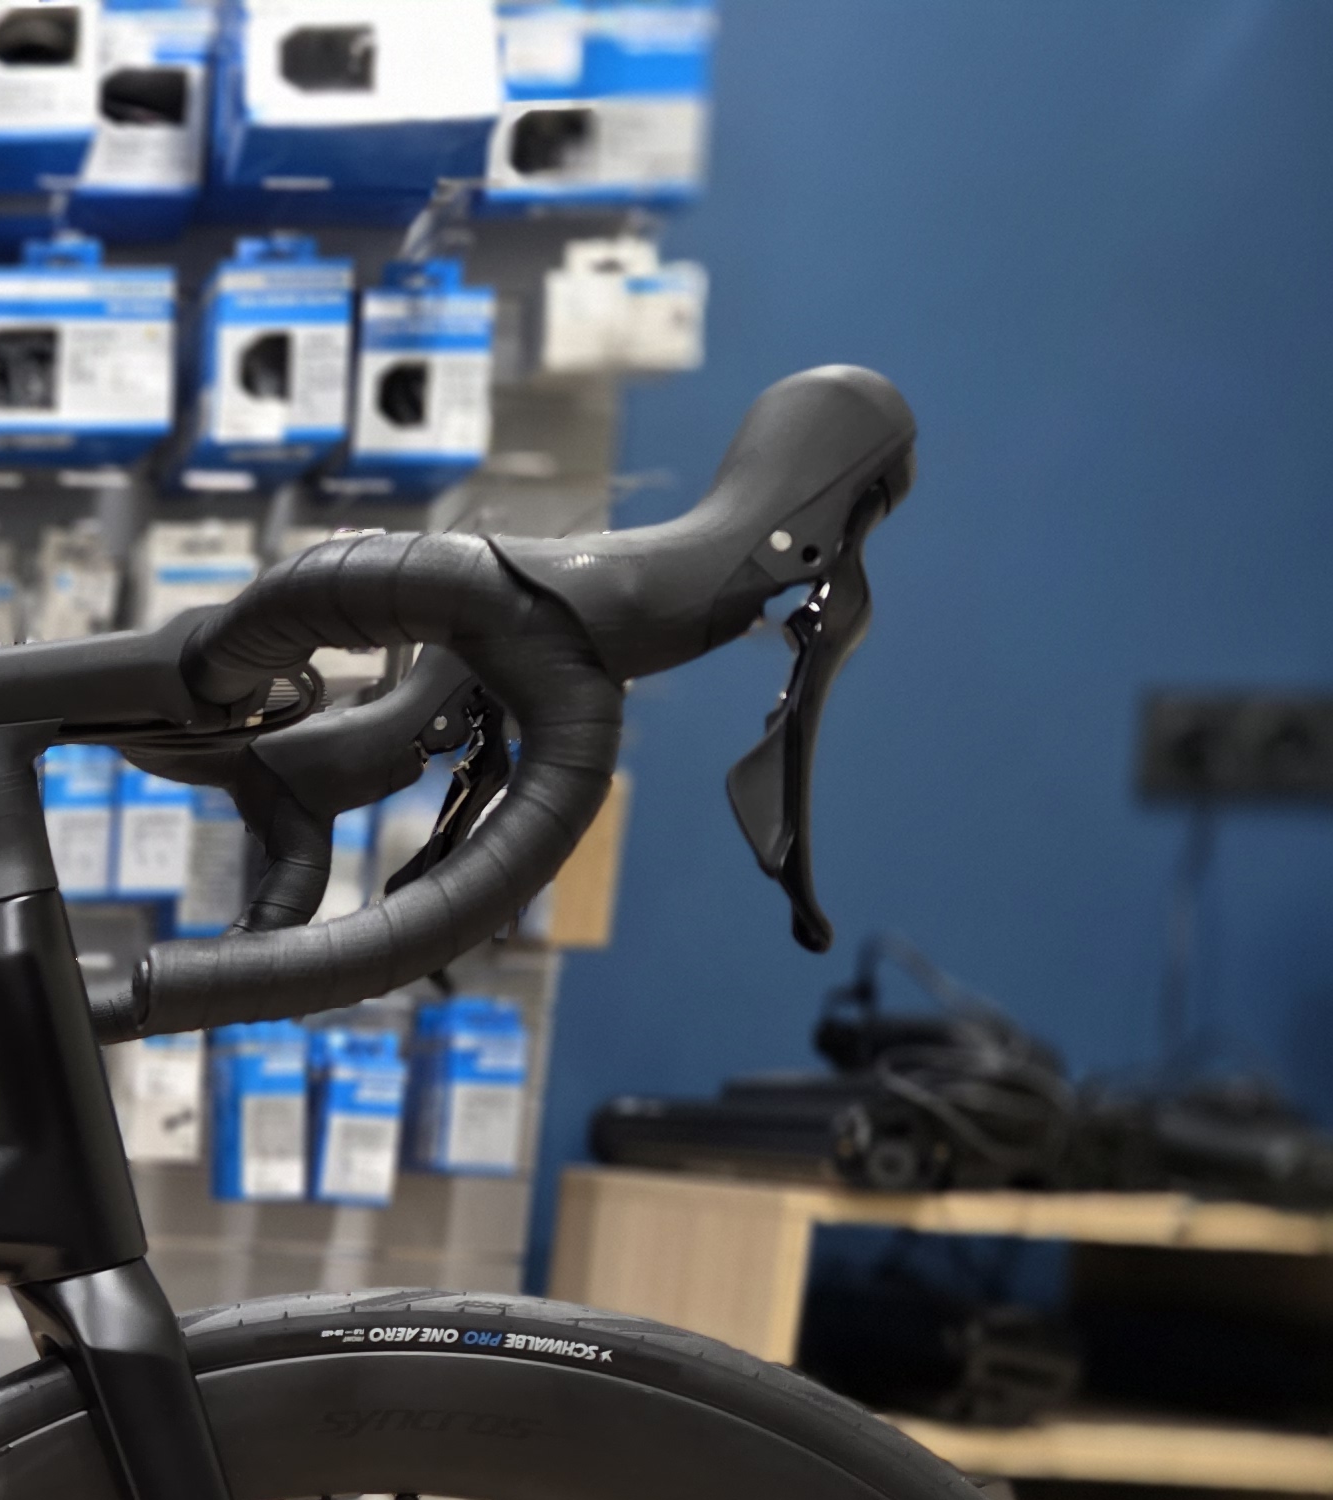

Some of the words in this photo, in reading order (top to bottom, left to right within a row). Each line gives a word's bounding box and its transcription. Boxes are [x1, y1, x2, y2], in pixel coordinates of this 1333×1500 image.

[368, 1326, 417, 1344] AERO
[418, 1327, 459, 1344] ONE
[463, 1330, 502, 1348] PRO
[503, 1332, 599, 1362] SCHWALBE
